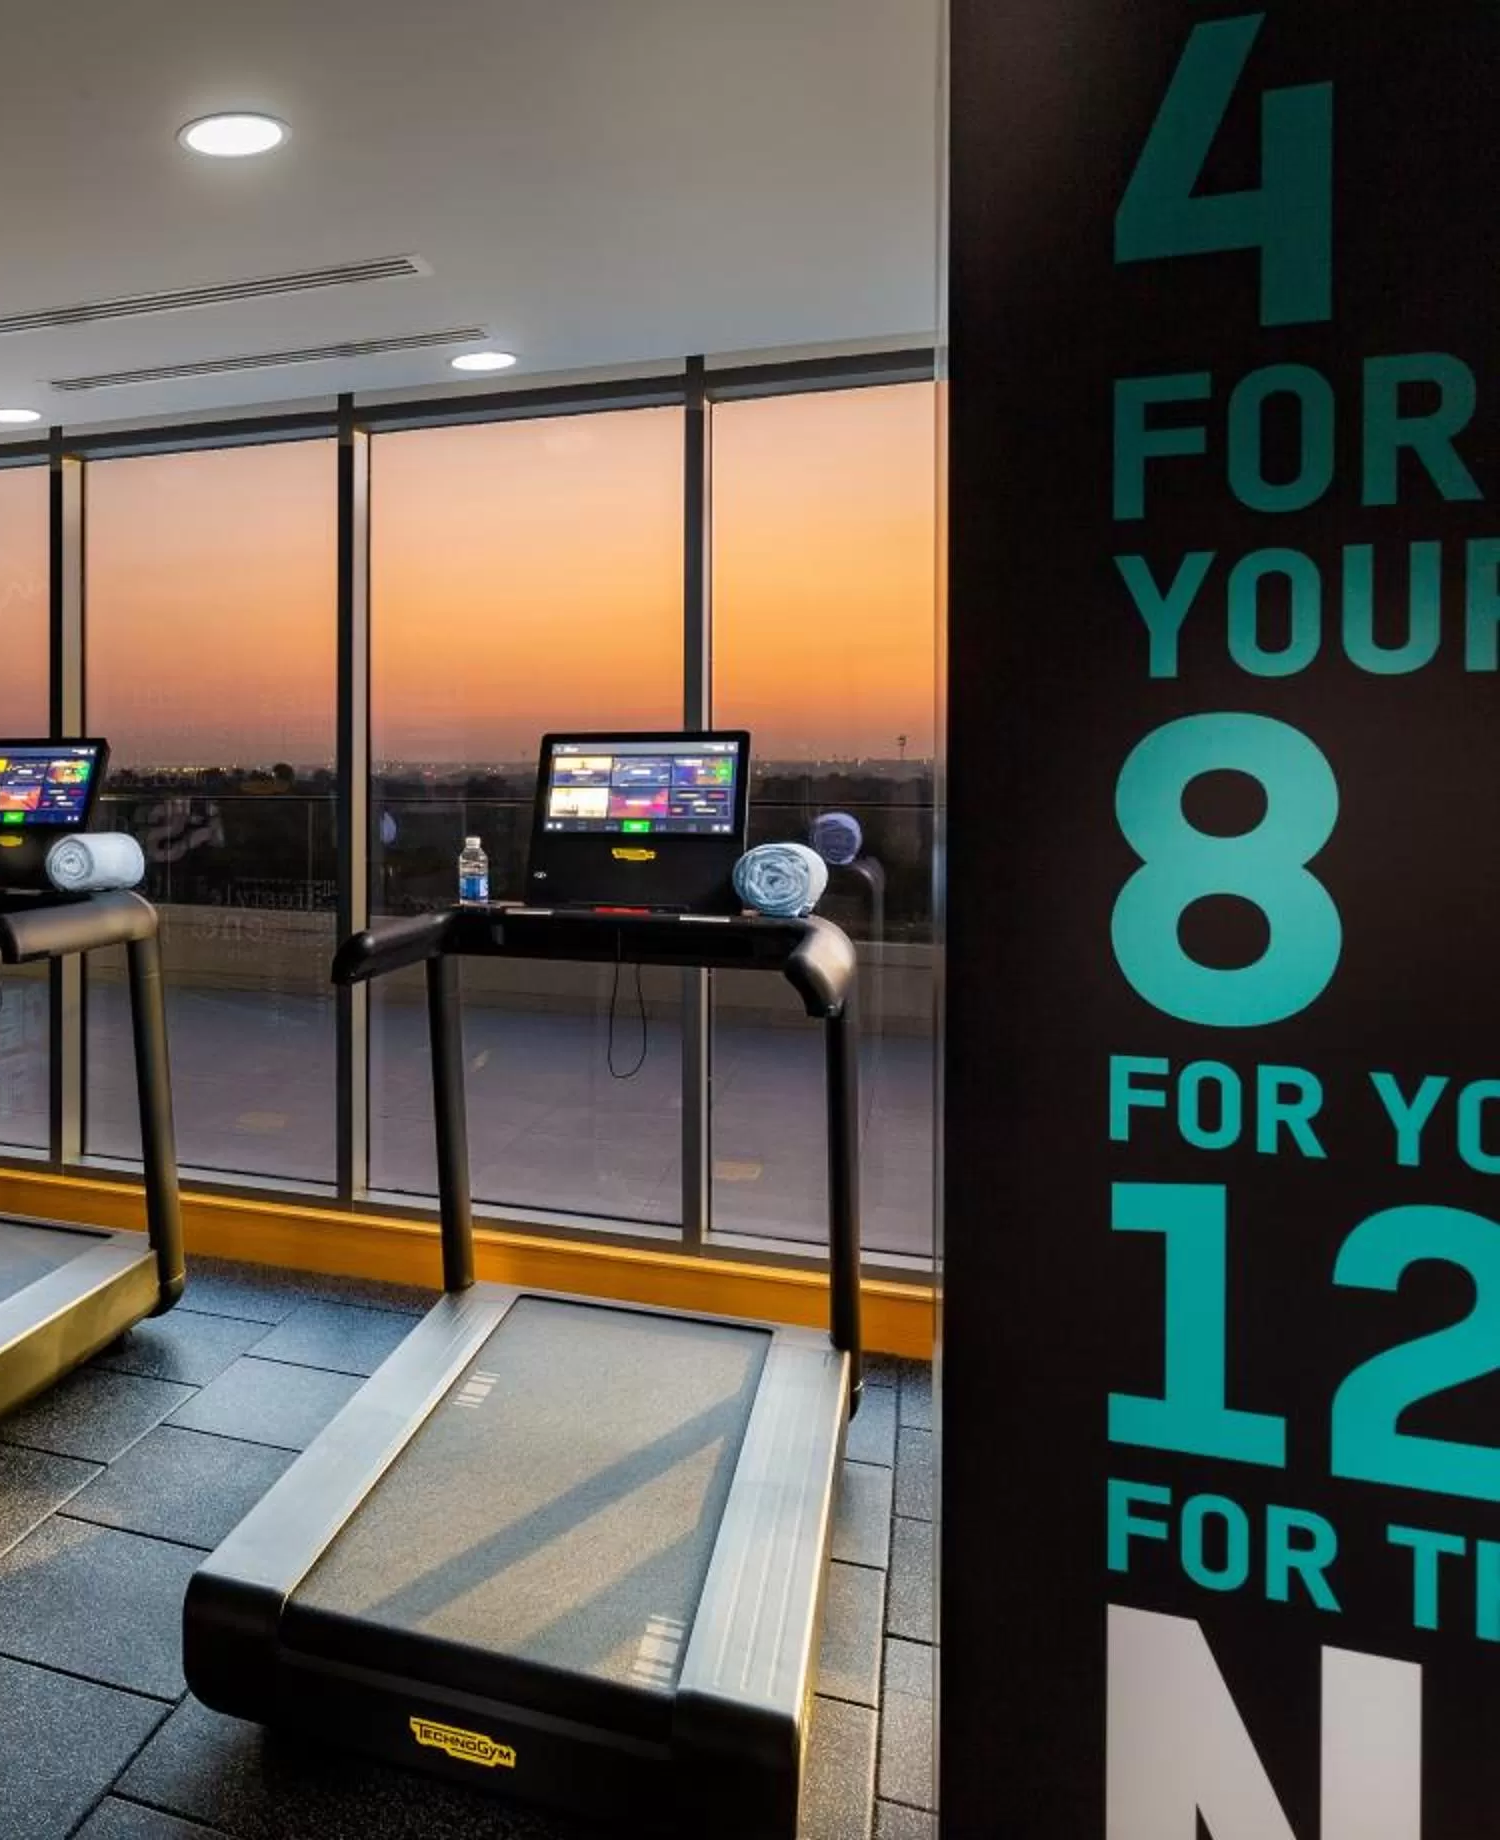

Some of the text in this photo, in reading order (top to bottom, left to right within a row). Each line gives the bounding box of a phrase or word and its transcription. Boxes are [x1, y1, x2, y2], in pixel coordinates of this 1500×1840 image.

[1113, 12, 1333, 327] 4
[1112, 351, 1484, 520] FOR
[1111, 711, 1342, 1028] 8
[1108, 1055, 1328, 1159] FOR
[1107, 1181, 1500, 1502] 12
[1107, 1477, 1342, 1613] FOR
